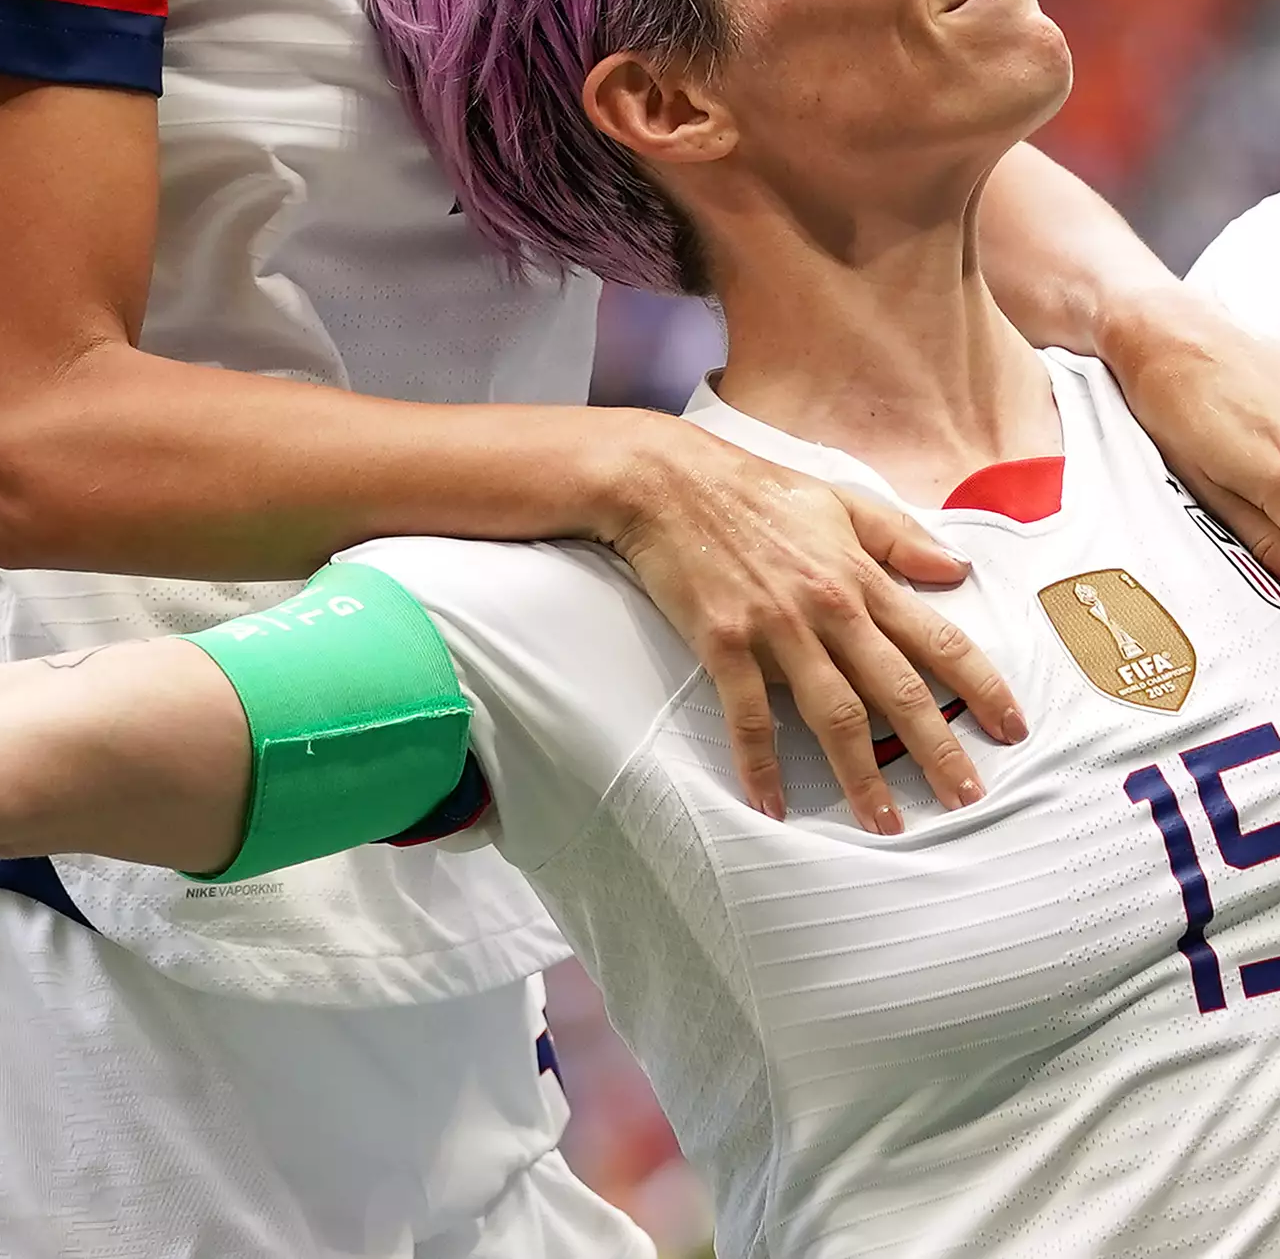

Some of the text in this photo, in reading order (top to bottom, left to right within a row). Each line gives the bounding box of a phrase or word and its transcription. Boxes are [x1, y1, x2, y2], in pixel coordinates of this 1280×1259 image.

[1117, 653, 1174, 685] FIFA
[1145, 680, 1176, 700] 2015
[186, 882, 284, 899] NIKE VAPORKNIT
